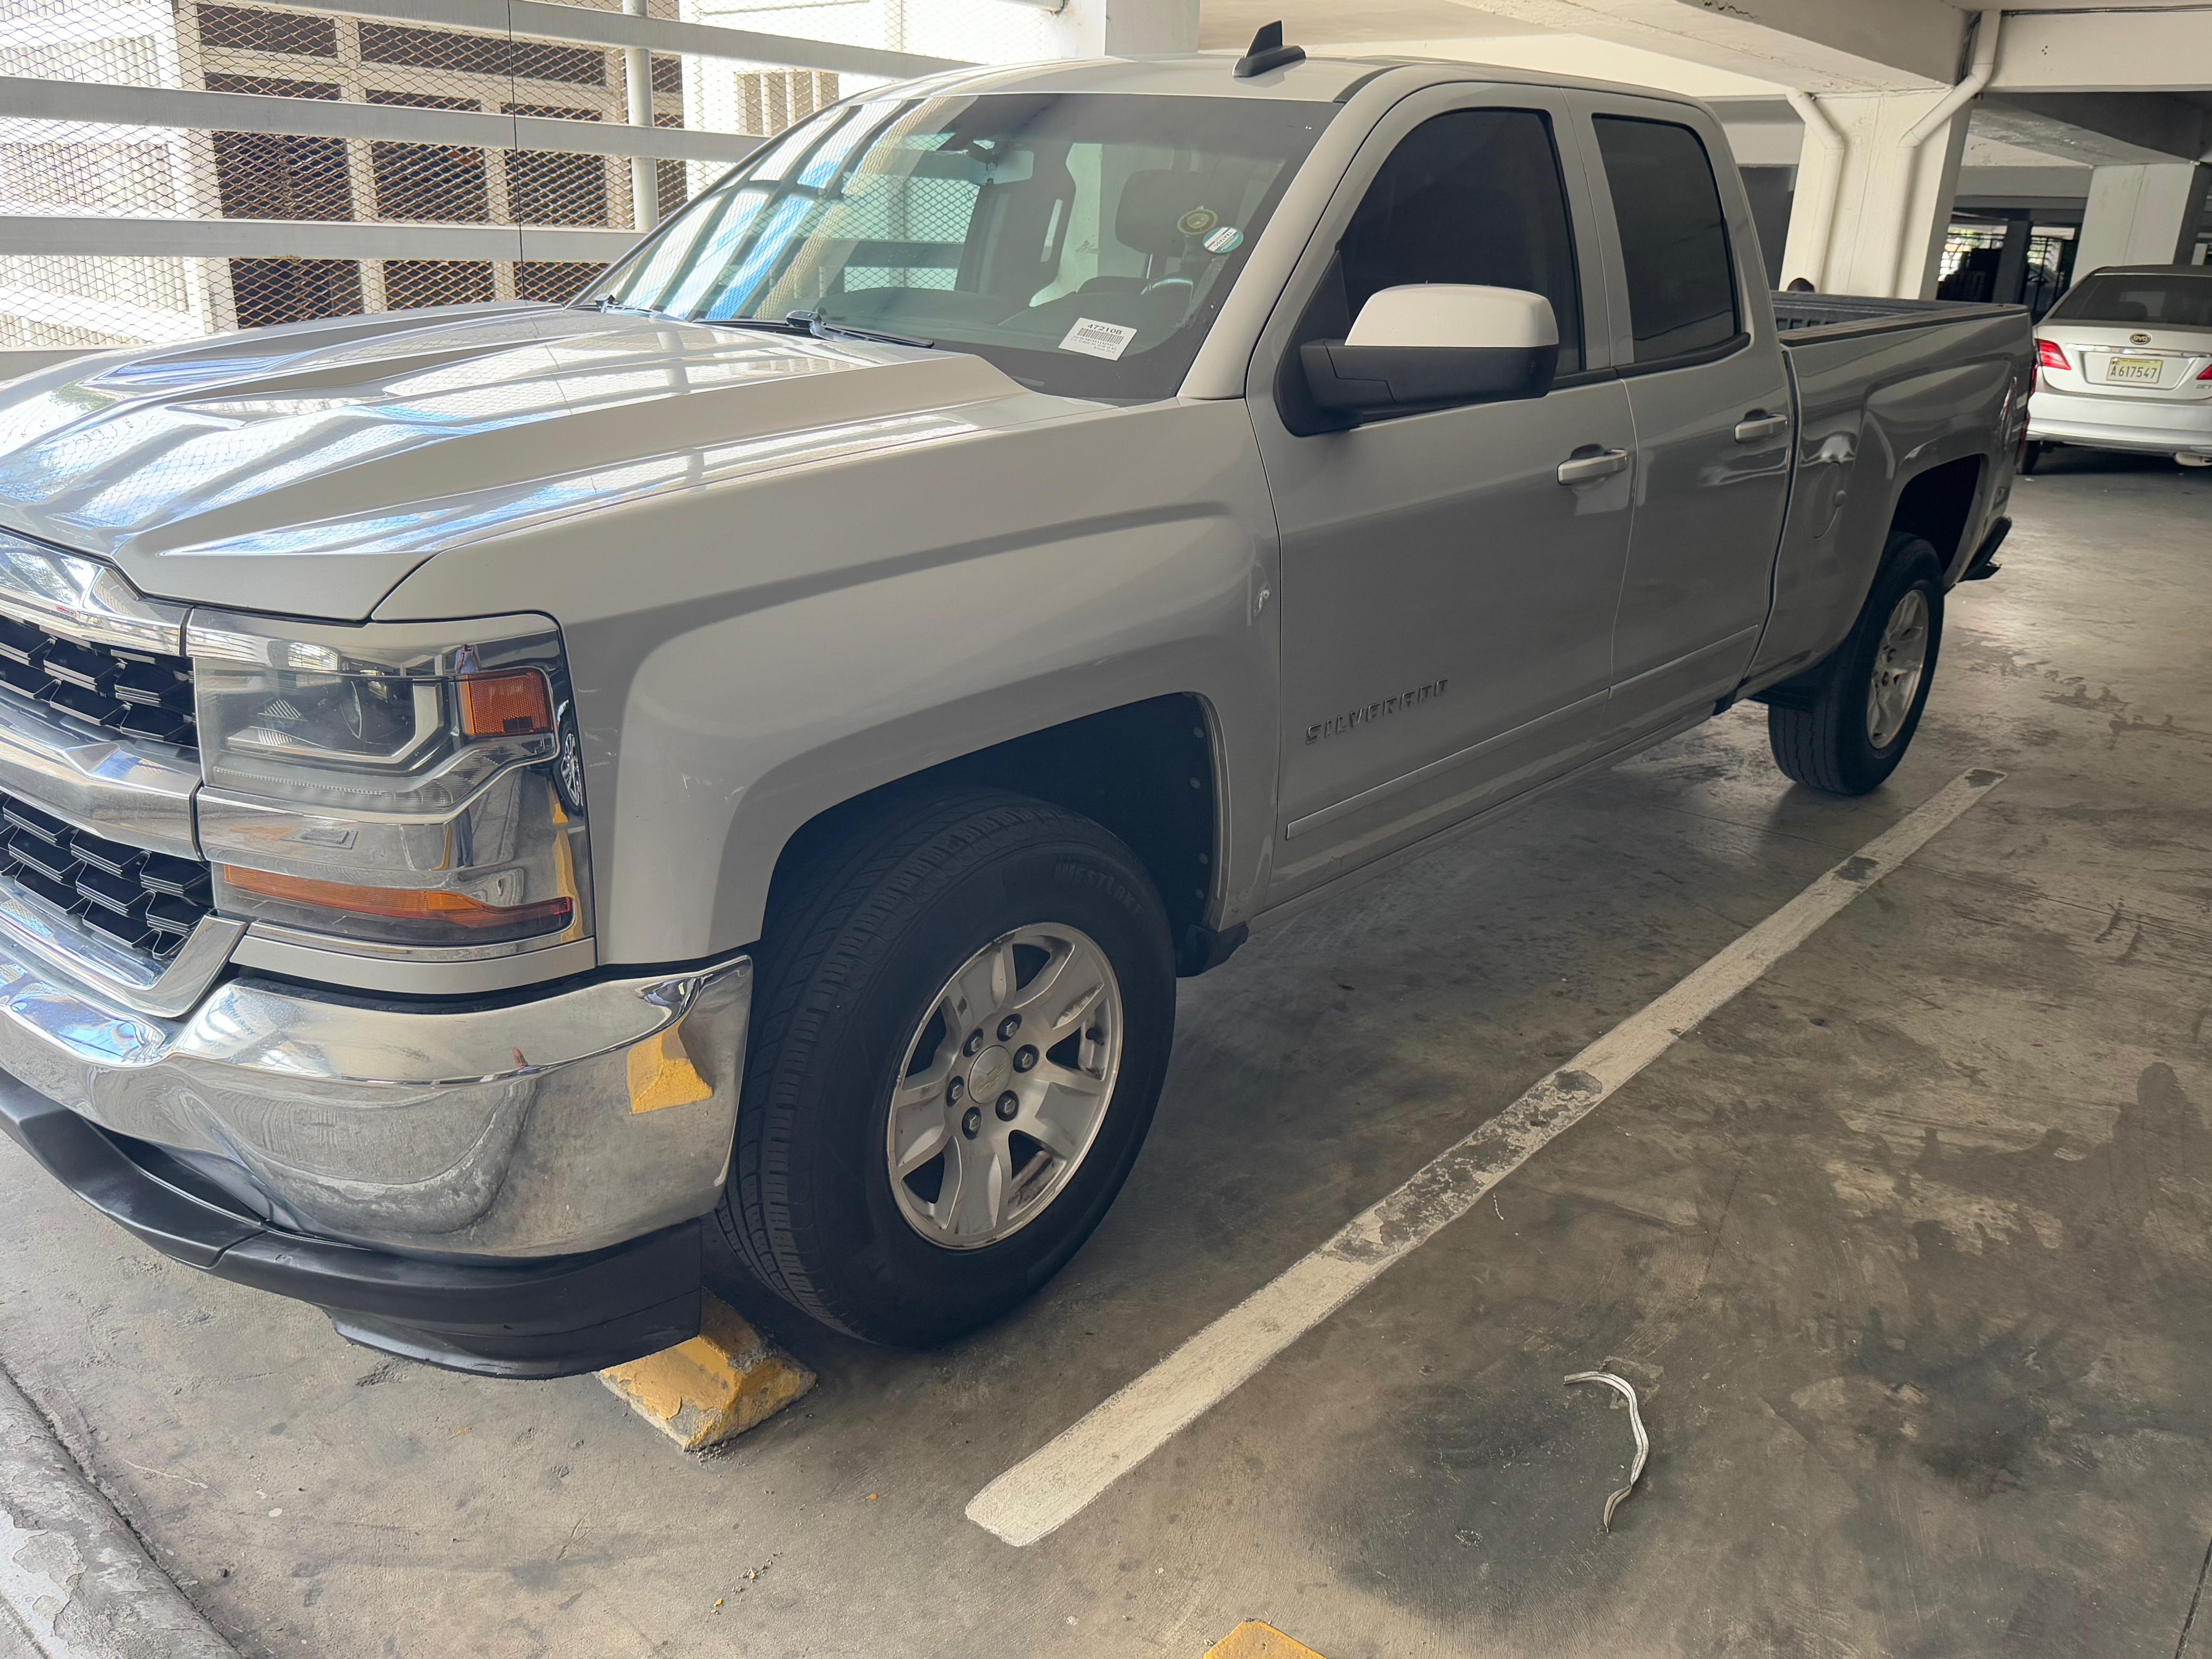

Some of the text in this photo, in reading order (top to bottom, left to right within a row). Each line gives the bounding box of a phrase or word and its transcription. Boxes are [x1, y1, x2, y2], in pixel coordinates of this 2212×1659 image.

[2110, 365, 2157, 379] A617547
[1305, 679, 1448, 745] SILVERADO
[1054, 862, 1144, 919] WESTLAKE
